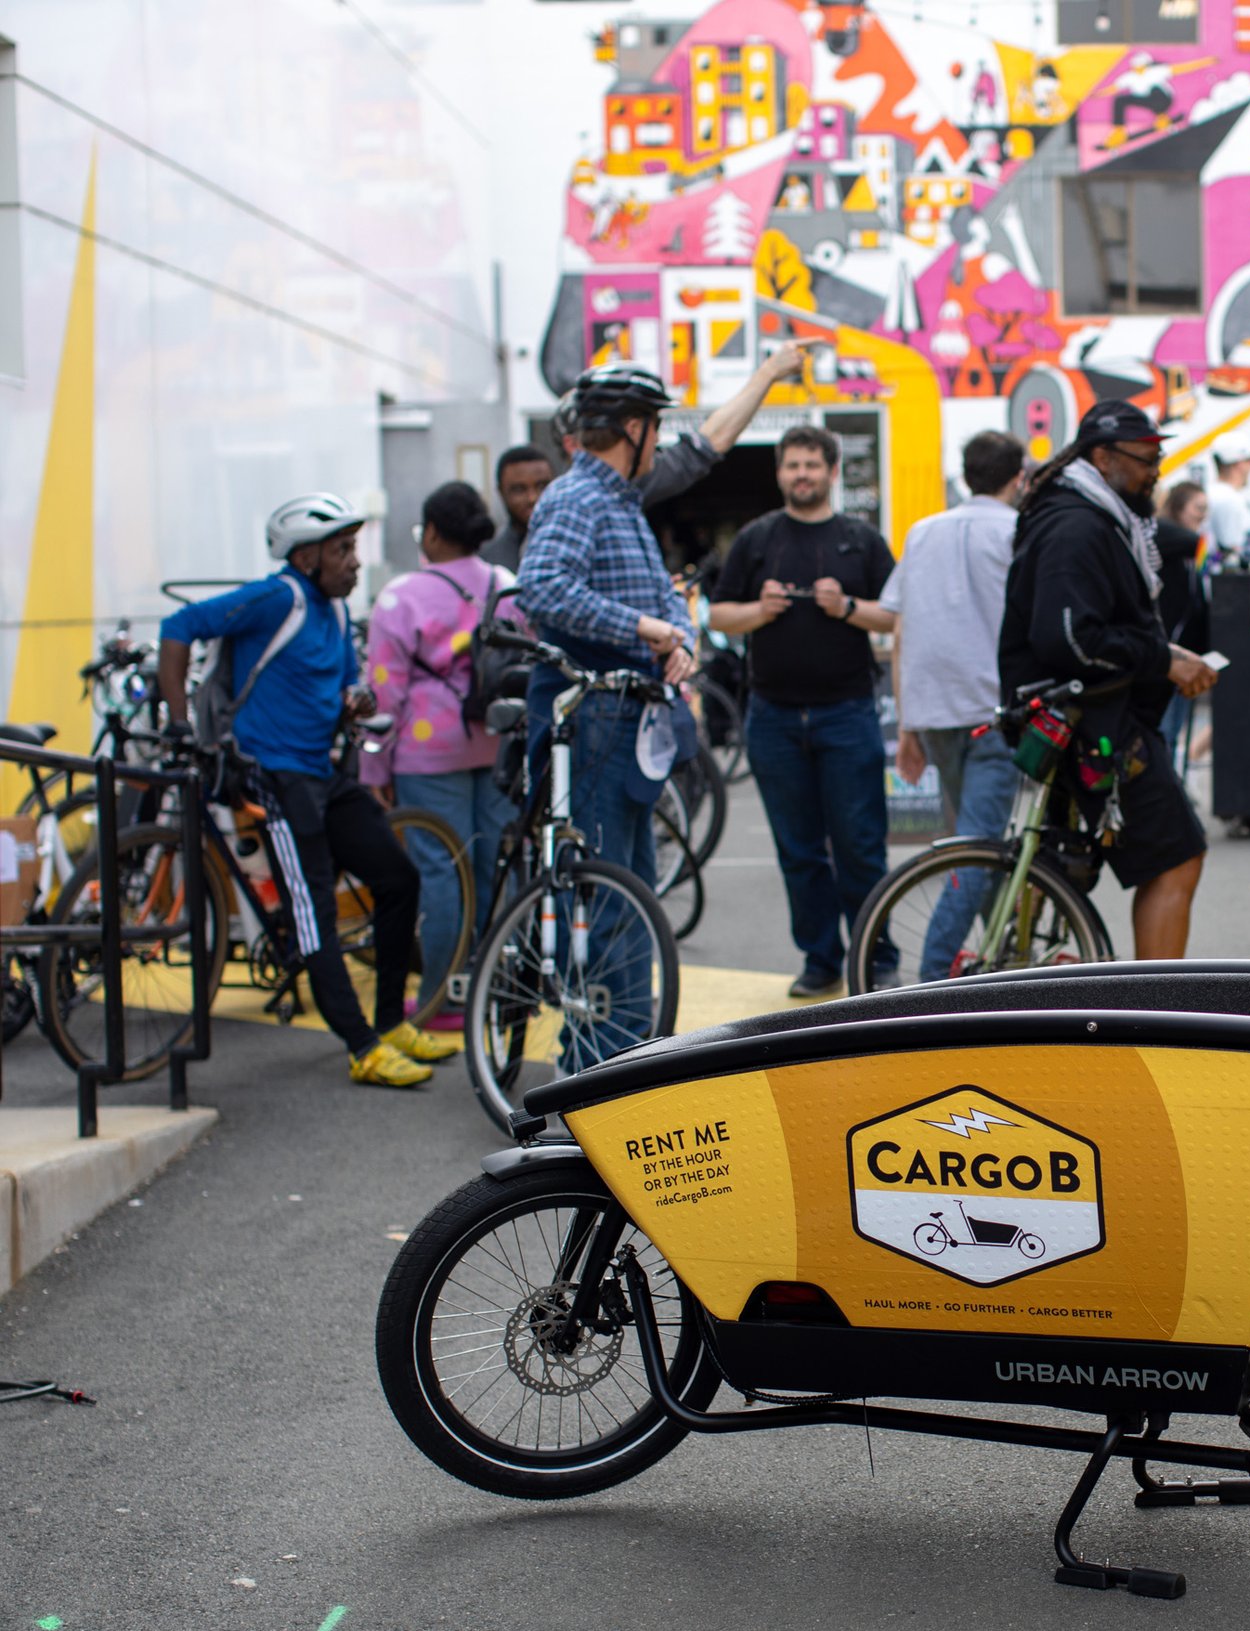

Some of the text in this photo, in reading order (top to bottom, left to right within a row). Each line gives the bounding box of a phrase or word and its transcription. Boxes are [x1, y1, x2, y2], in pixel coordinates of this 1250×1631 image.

[625, 1121, 730, 1160] RENT ME
[643, 1149, 722, 1175] BY THE HOUR
[644, 1164, 730, 1192] OR BY THE DAY
[656, 1185, 733, 1207] rideCargoB.com
[864, 1299, 1113, 1319] HAUL MORE GO FURTHER CARGO BETTER
[995, 1361, 1209, 1391] URBAN ARROW
